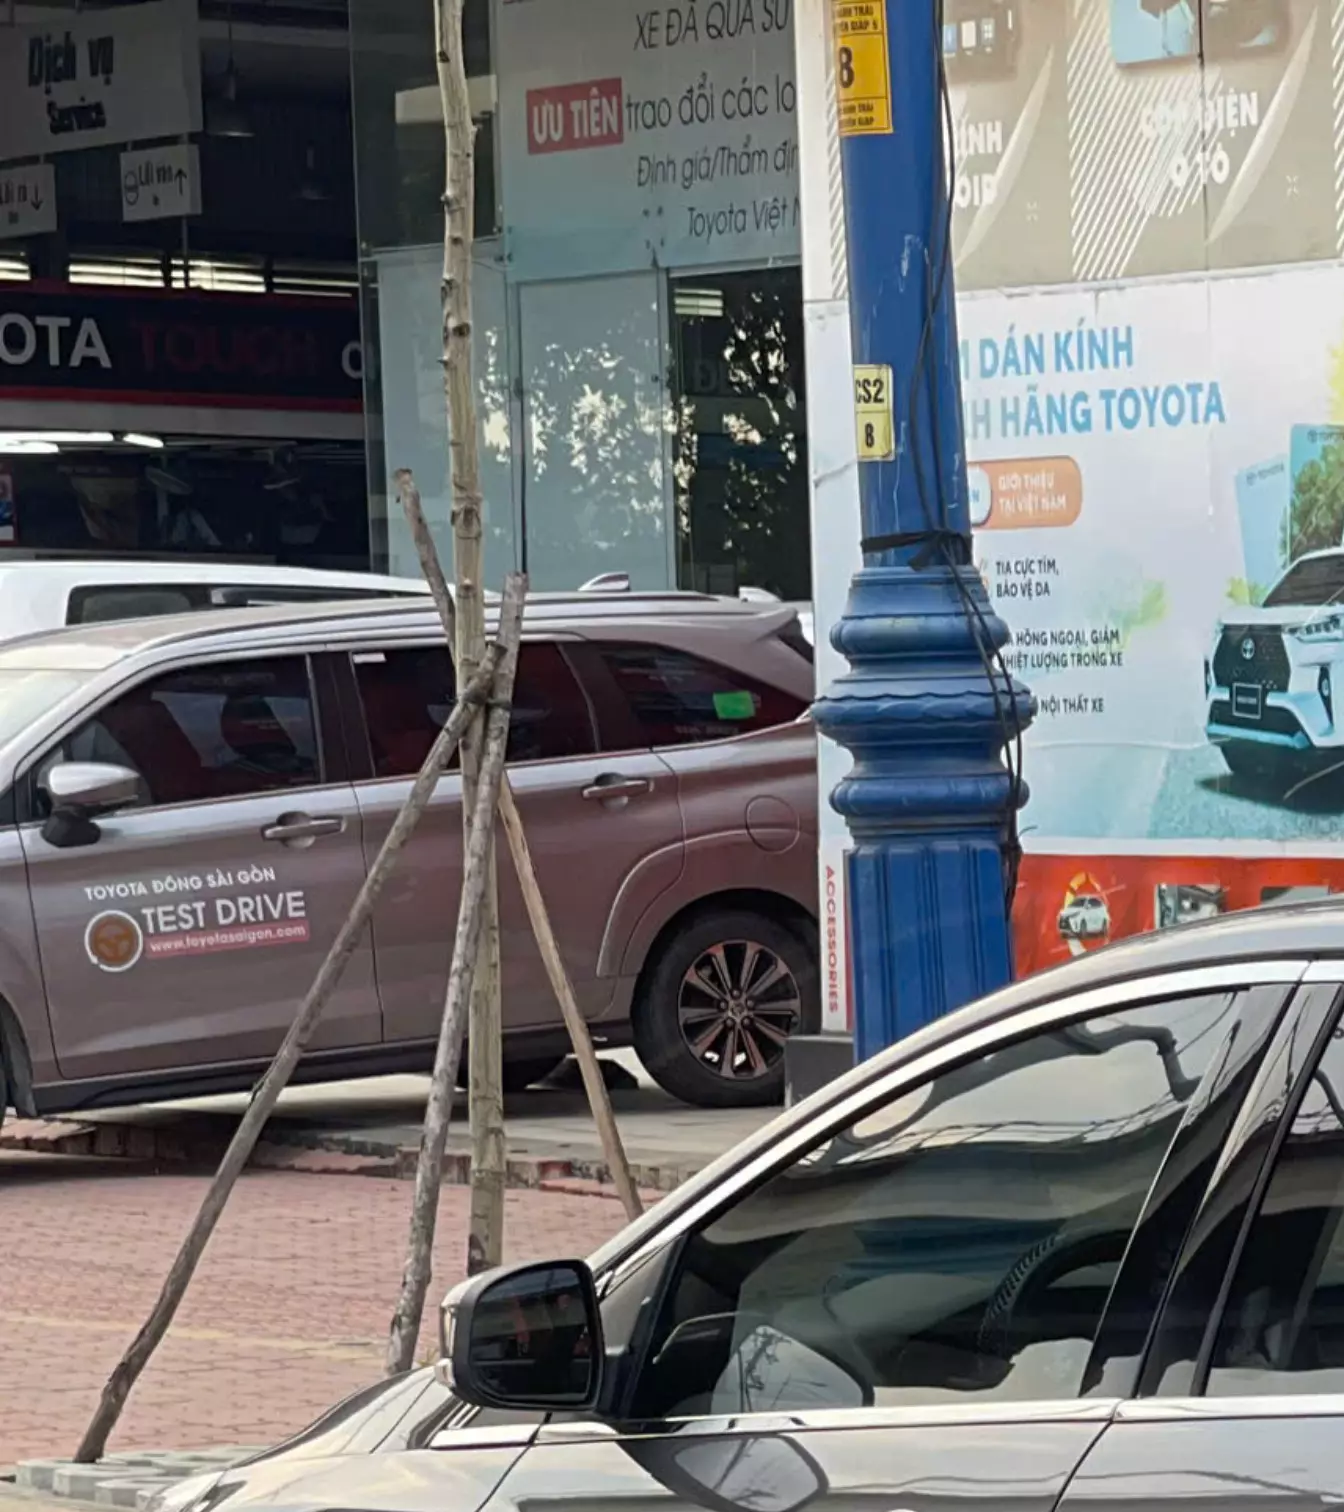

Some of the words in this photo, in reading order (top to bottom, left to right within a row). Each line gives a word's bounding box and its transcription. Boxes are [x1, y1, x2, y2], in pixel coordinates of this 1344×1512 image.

[634, 11, 661, 50] XE
[706, 0, 755, 39] QUA
[838, 45, 856, 89] 8
[533, 101, 564, 146] ƯU
[569, 88, 619, 141] TIÊN
[626, 95, 672, 132] trao
[678, 72, 715, 126] đổi
[721, 76, 768, 120] các
[637, 152, 677, 191] Định
[681, 134, 768, 190] giá/Thẩm
[687, 203, 747, 244] Toyota
[753, 197, 788, 237] Việt
[980, 318, 1046, 380] DÁN
[1055, 316, 1135, 374] KÍNH
[1001, 384, 1092, 436] HÃNG
[1098, 381, 1226, 432] TOYOTA
[864, 423, 876, 448] 8
[996, 560, 1012, 576] TIA
[1014, 557, 1035, 578] CỰC
[1035, 581, 1051, 597] DA
[1070, 650, 1107, 668] TRONG
[1109, 651, 1123, 667] XE
[1091, 698, 1105, 713] XE
[84, 882, 148, 902] TOYOTA
[152, 873, 202, 895] ĐÔNG
[207, 867, 234, 888] SÀI
[238, 863, 276, 885] GÒN
[142, 901, 206, 934] TEST
[215, 891, 306, 926] DRIVE
[150, 923, 307, 954] www.toyotasaigon.com
[825, 864, 839, 1014] ACCESSORIES
